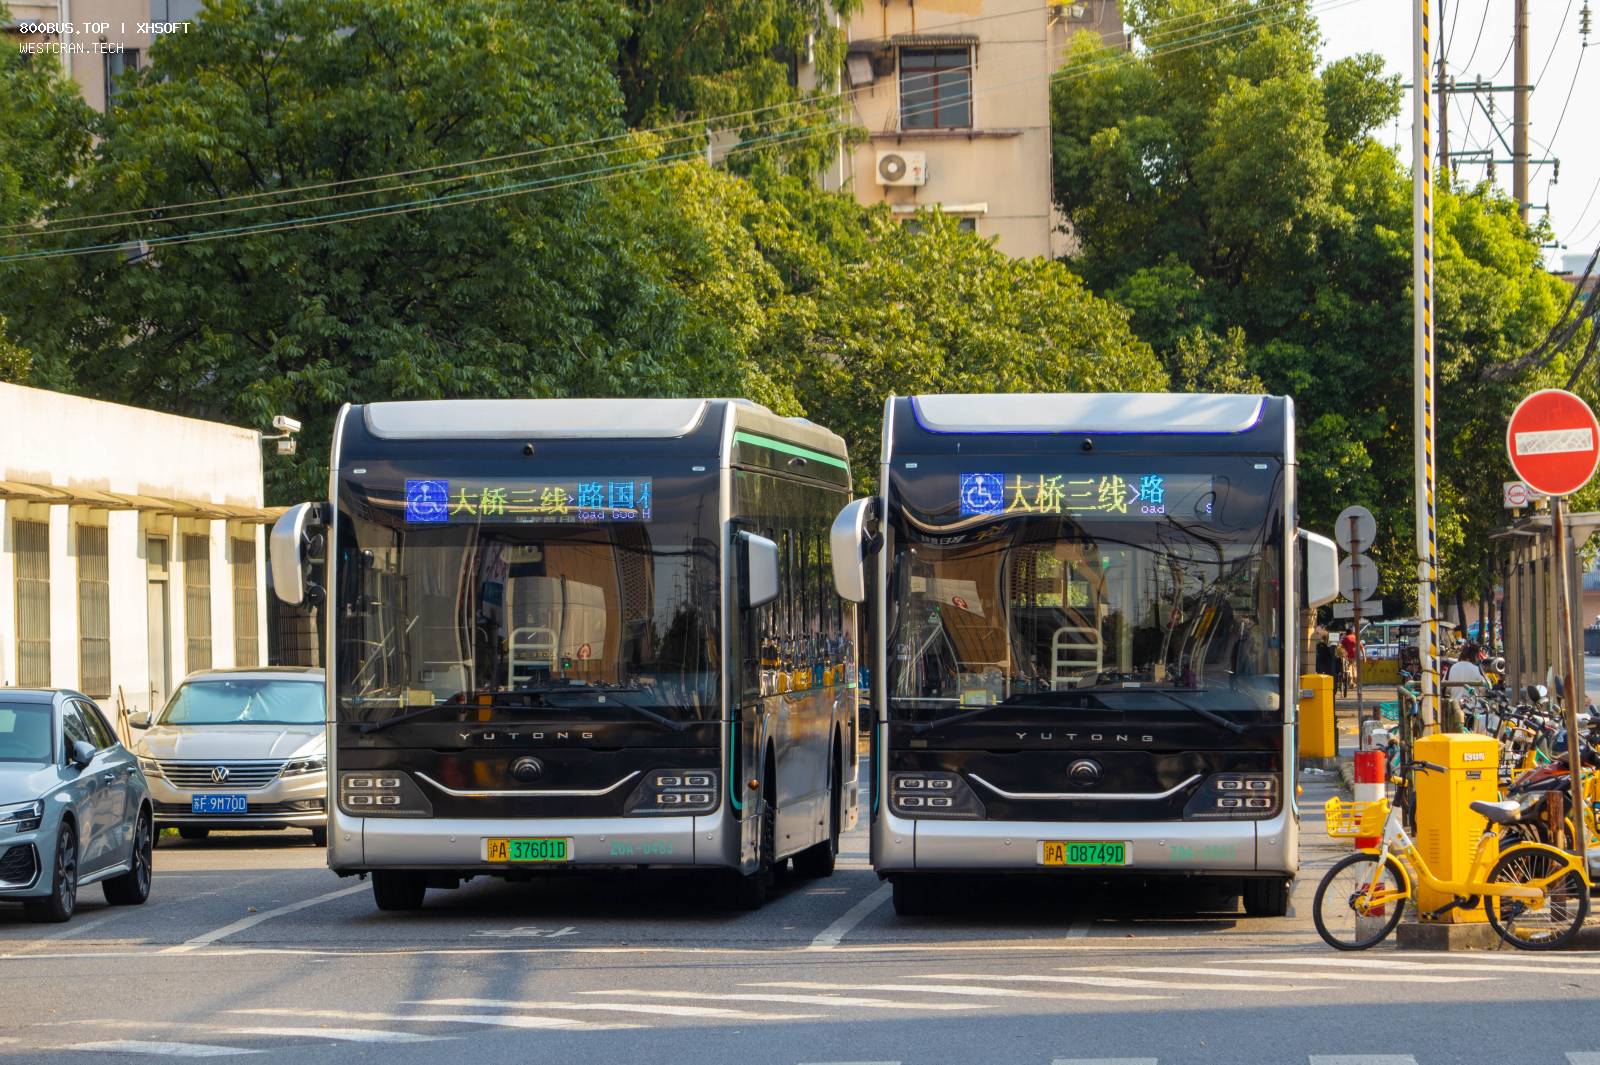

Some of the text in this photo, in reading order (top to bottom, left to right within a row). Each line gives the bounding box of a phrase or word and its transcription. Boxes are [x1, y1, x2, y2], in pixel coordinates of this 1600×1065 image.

[450, 487, 568, 515] 大桥三线
[1005, 474, 1128, 513] 大桥三线
[459, 732, 593, 740] YUTONG
[1015, 732, 1153, 742] YUTONG
